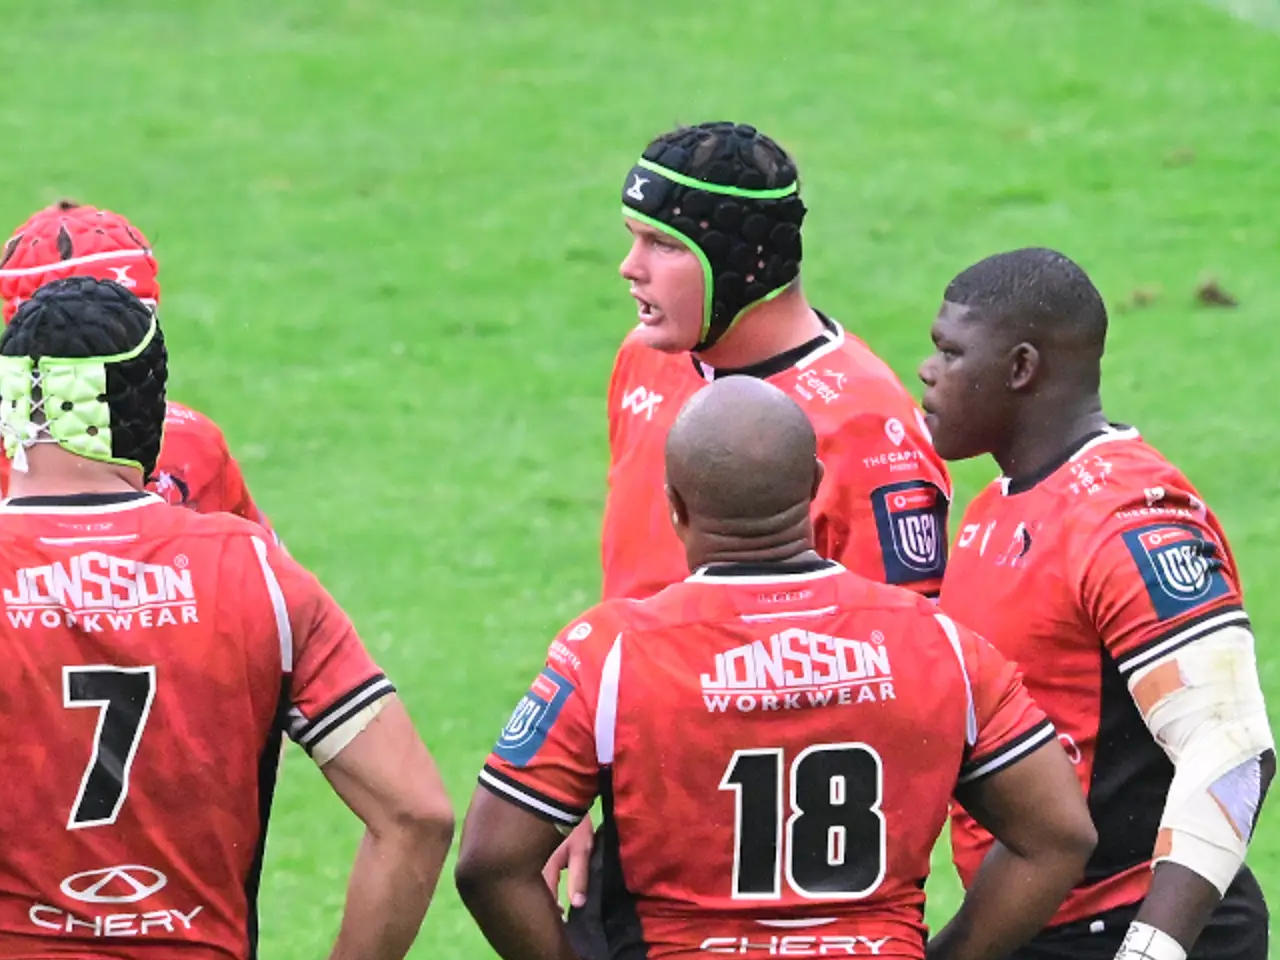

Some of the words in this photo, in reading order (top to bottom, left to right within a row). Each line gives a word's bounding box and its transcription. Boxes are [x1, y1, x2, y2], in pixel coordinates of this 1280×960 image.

[3, 552, 196, 608] JONSSON
[700, 628, 890, 688] JONSSON
[702, 683, 896, 712] WORKWEAR
[62, 664, 157, 830] 7
[720, 742, 887, 900] 18
[29, 903, 204, 937] CHERY
[700, 936, 892, 955] CHERY
